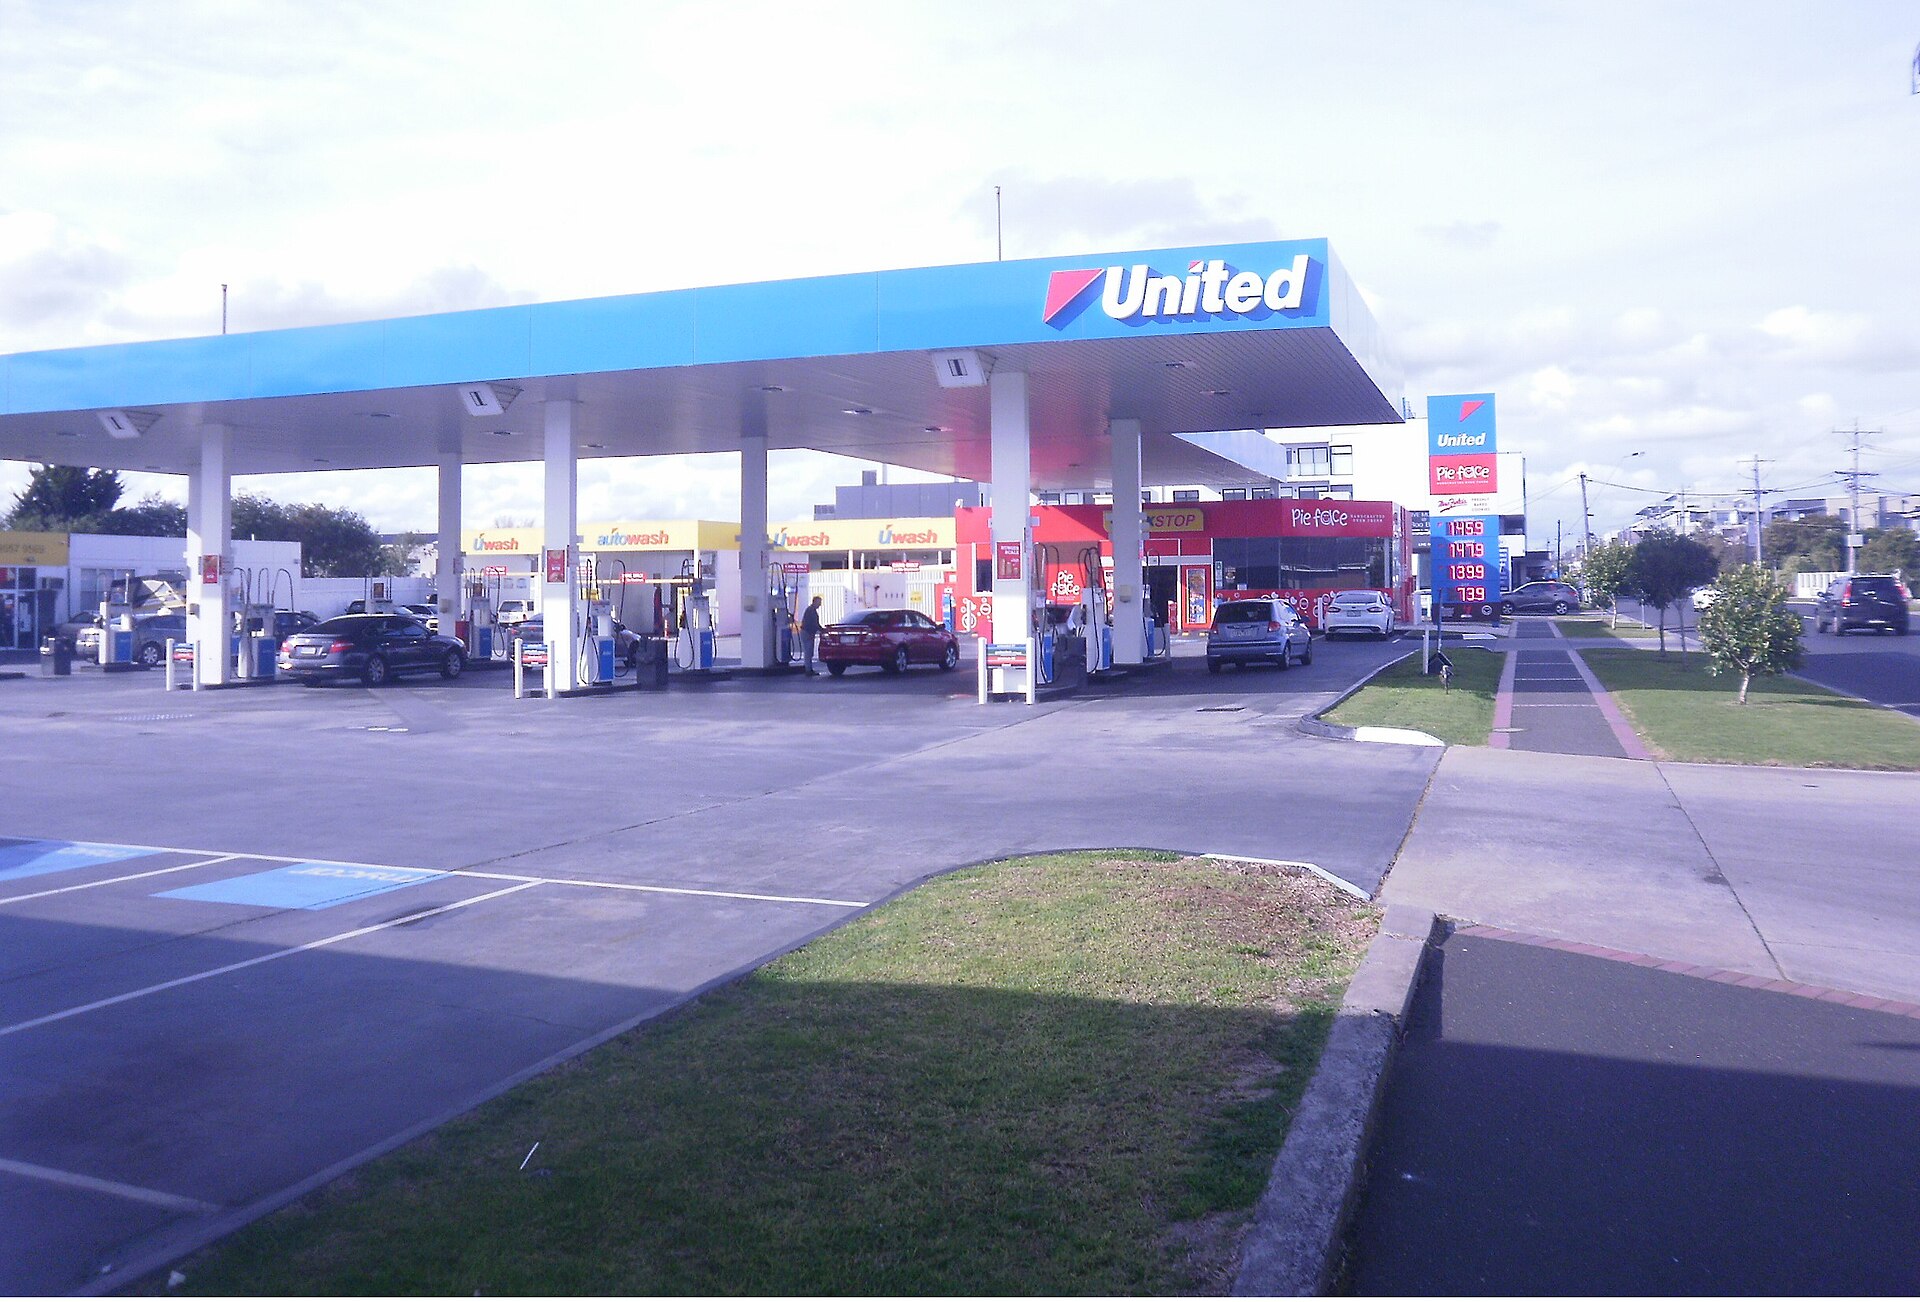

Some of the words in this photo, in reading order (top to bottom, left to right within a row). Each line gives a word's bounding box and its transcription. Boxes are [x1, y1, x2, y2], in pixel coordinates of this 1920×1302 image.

[1101, 254, 1309, 319] United
[1437, 431, 1486, 447] United
[1291, 508, 1311, 527] Pie
[1313, 508, 1348, 527] face
